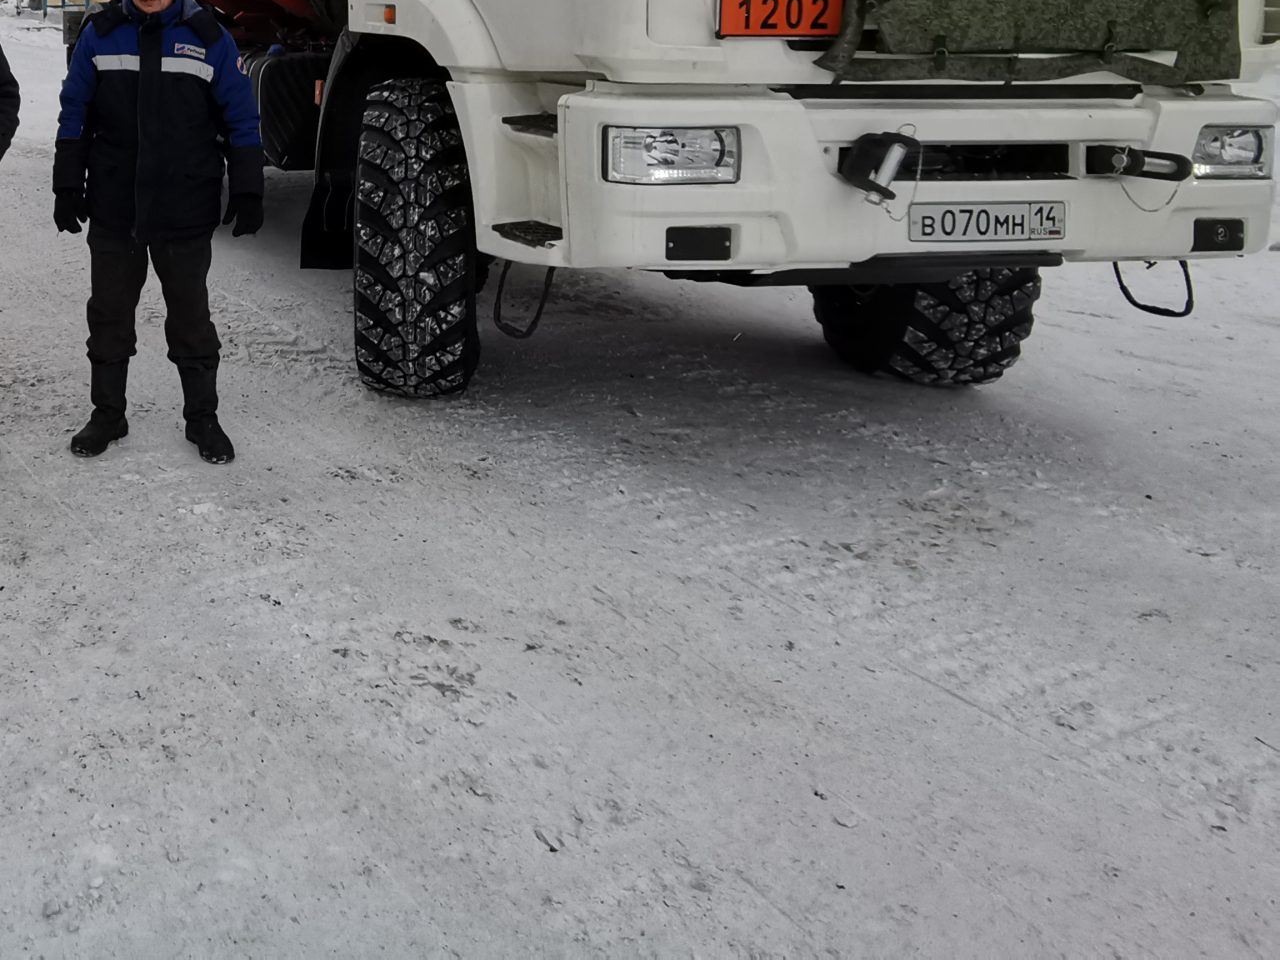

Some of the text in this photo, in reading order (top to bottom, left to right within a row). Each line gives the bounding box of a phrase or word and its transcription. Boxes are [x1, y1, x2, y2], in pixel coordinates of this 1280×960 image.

[921, 206, 1056, 236] В070МН 14
[1031, 227, 1048, 235] RUS
